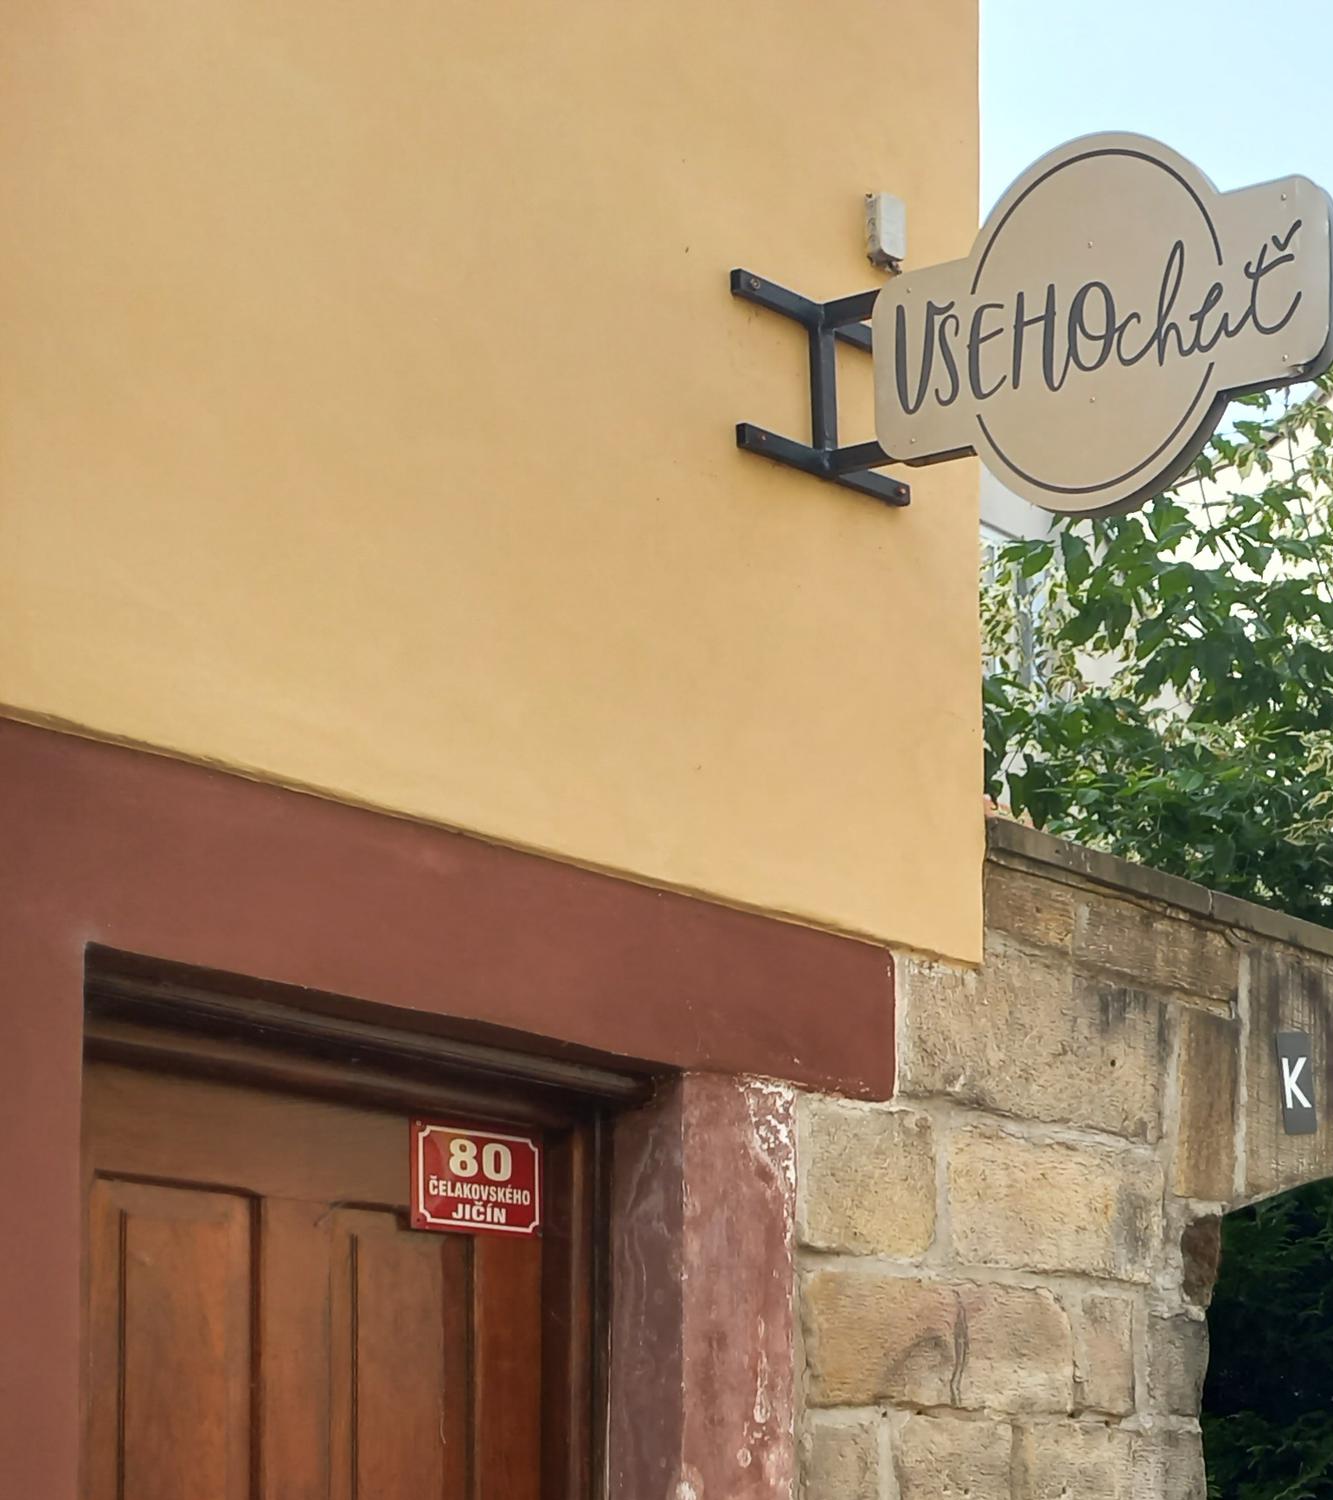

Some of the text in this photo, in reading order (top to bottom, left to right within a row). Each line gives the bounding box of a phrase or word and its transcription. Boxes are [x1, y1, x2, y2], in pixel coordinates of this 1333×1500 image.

[449, 1138, 512, 1182] 80
[428, 1175, 531, 1206] ČELAKOVSKÉHO
[451, 1201, 507, 1224] JIČÍN
